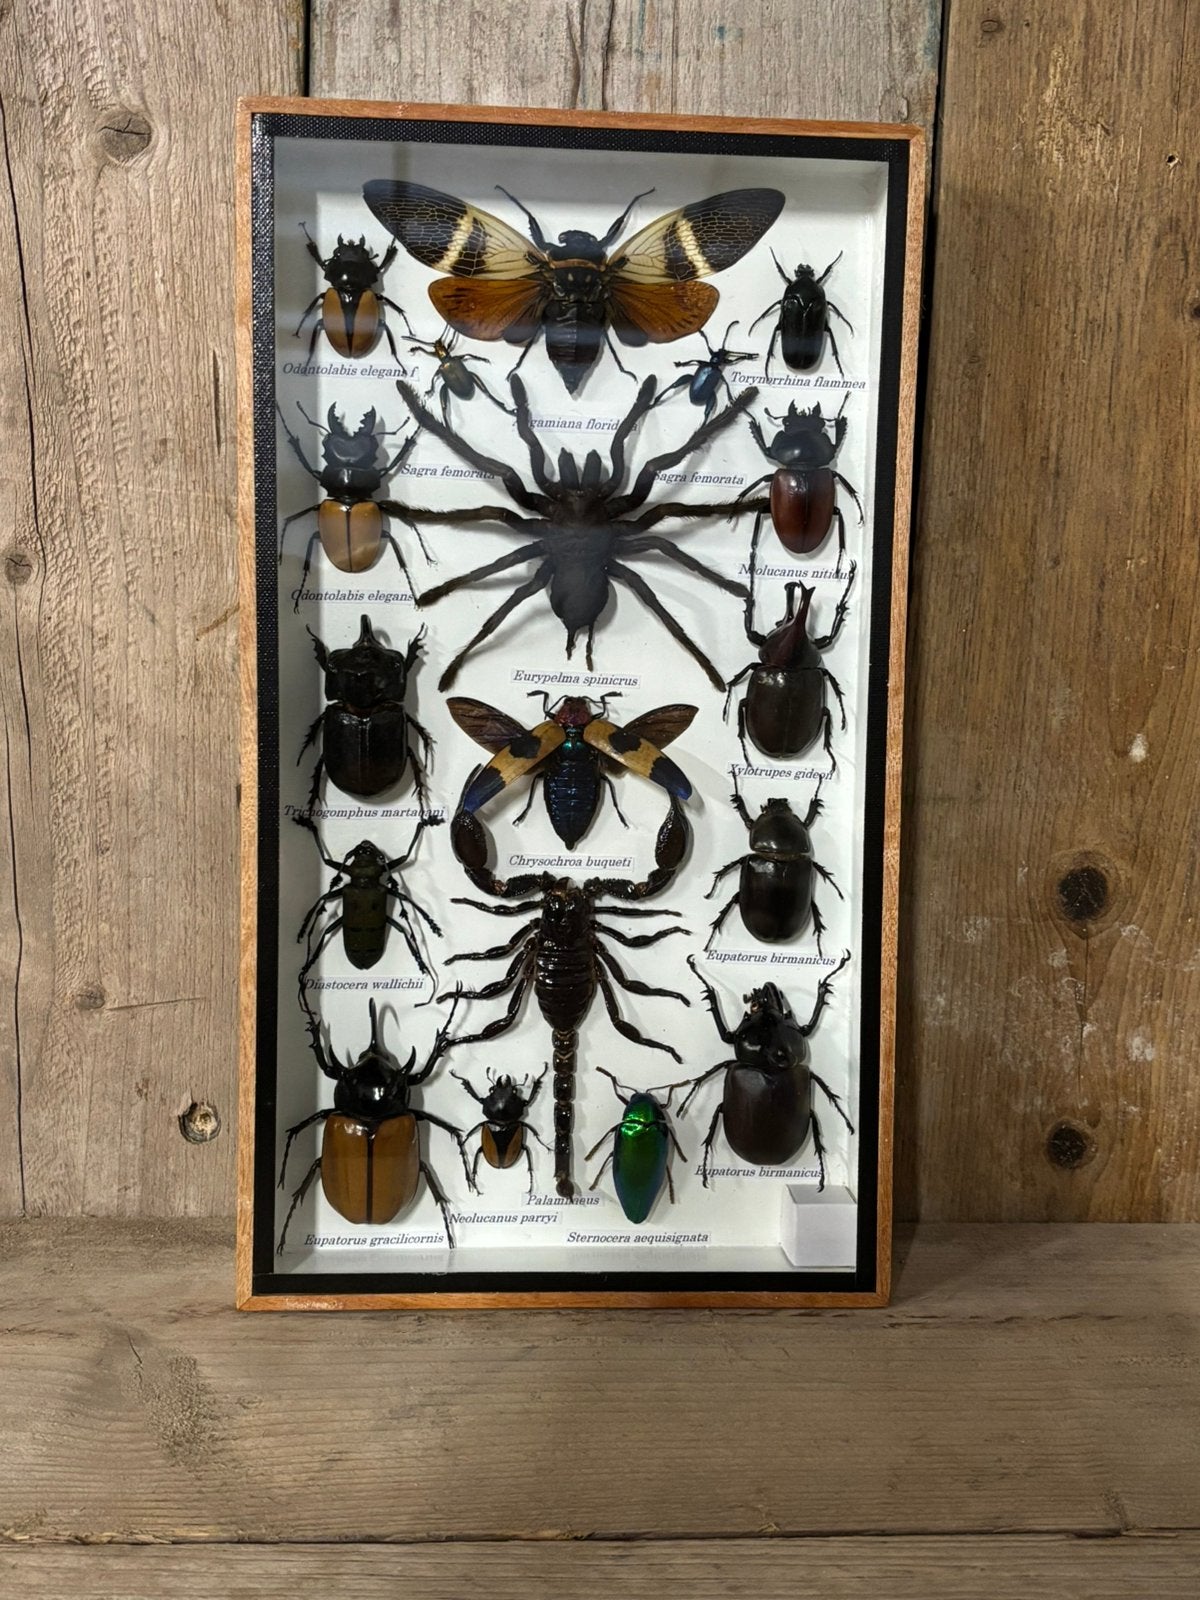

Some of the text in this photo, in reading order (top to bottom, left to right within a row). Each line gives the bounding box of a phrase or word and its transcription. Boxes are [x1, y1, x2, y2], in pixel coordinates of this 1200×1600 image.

[283, 363, 357, 377] Odontolabis
[813, 376, 866, 389] flammea
[511, 418, 638, 431] gamiana florida
[400, 464, 437, 478] Sagra
[690, 472, 744, 486] femorata
[738, 564, 808, 578] Nolucanus
[291, 589, 414, 603] Odontolabis elegans
[513, 670, 638, 687] Eurypelma spinicrus
[728, 764, 834, 781] Xylotrupes gideon
[509, 855, 631, 869] Chrysochroa buqueti
[705, 950, 836, 966] Eupatorus birmanicus
[305, 977, 424, 991] Diastocera wallichii
[759, 1166, 823, 1179] birmanicus
[449, 1212, 558, 1226] Neolucanus parryi
[304, 1232, 444, 1247] Eupatorus gracilicornis
[567, 1232, 708, 1246] Sternocera aequisignata
